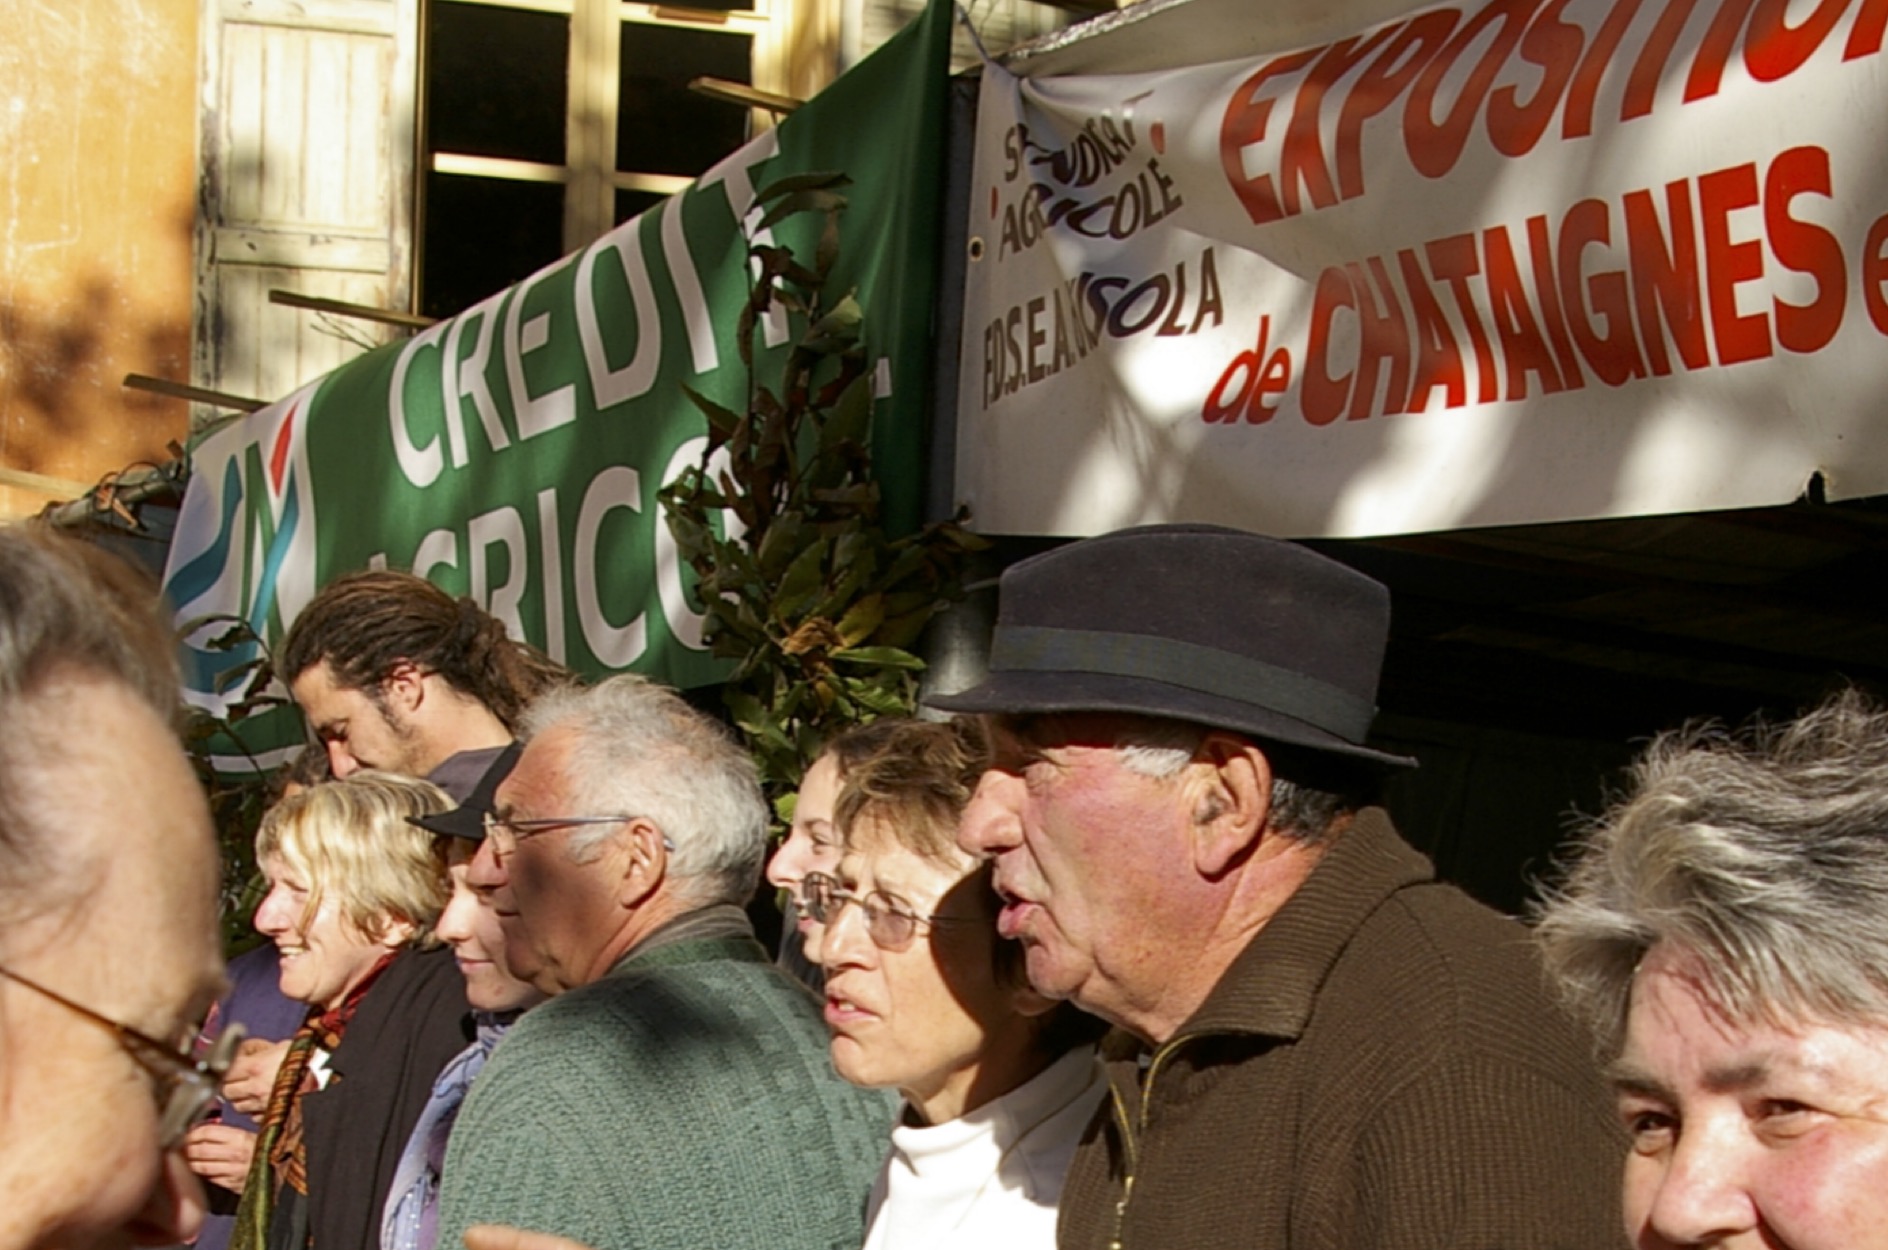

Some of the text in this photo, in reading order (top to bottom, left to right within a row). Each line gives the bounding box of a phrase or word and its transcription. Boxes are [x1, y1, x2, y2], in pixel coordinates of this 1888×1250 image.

[1219, 0, 1888, 225] EXPOSITI
[388, 125, 791, 489] CREDIT
[1202, 314, 1291, 426] de
[1300, 144, 1849, 427] CHATAIGNES
